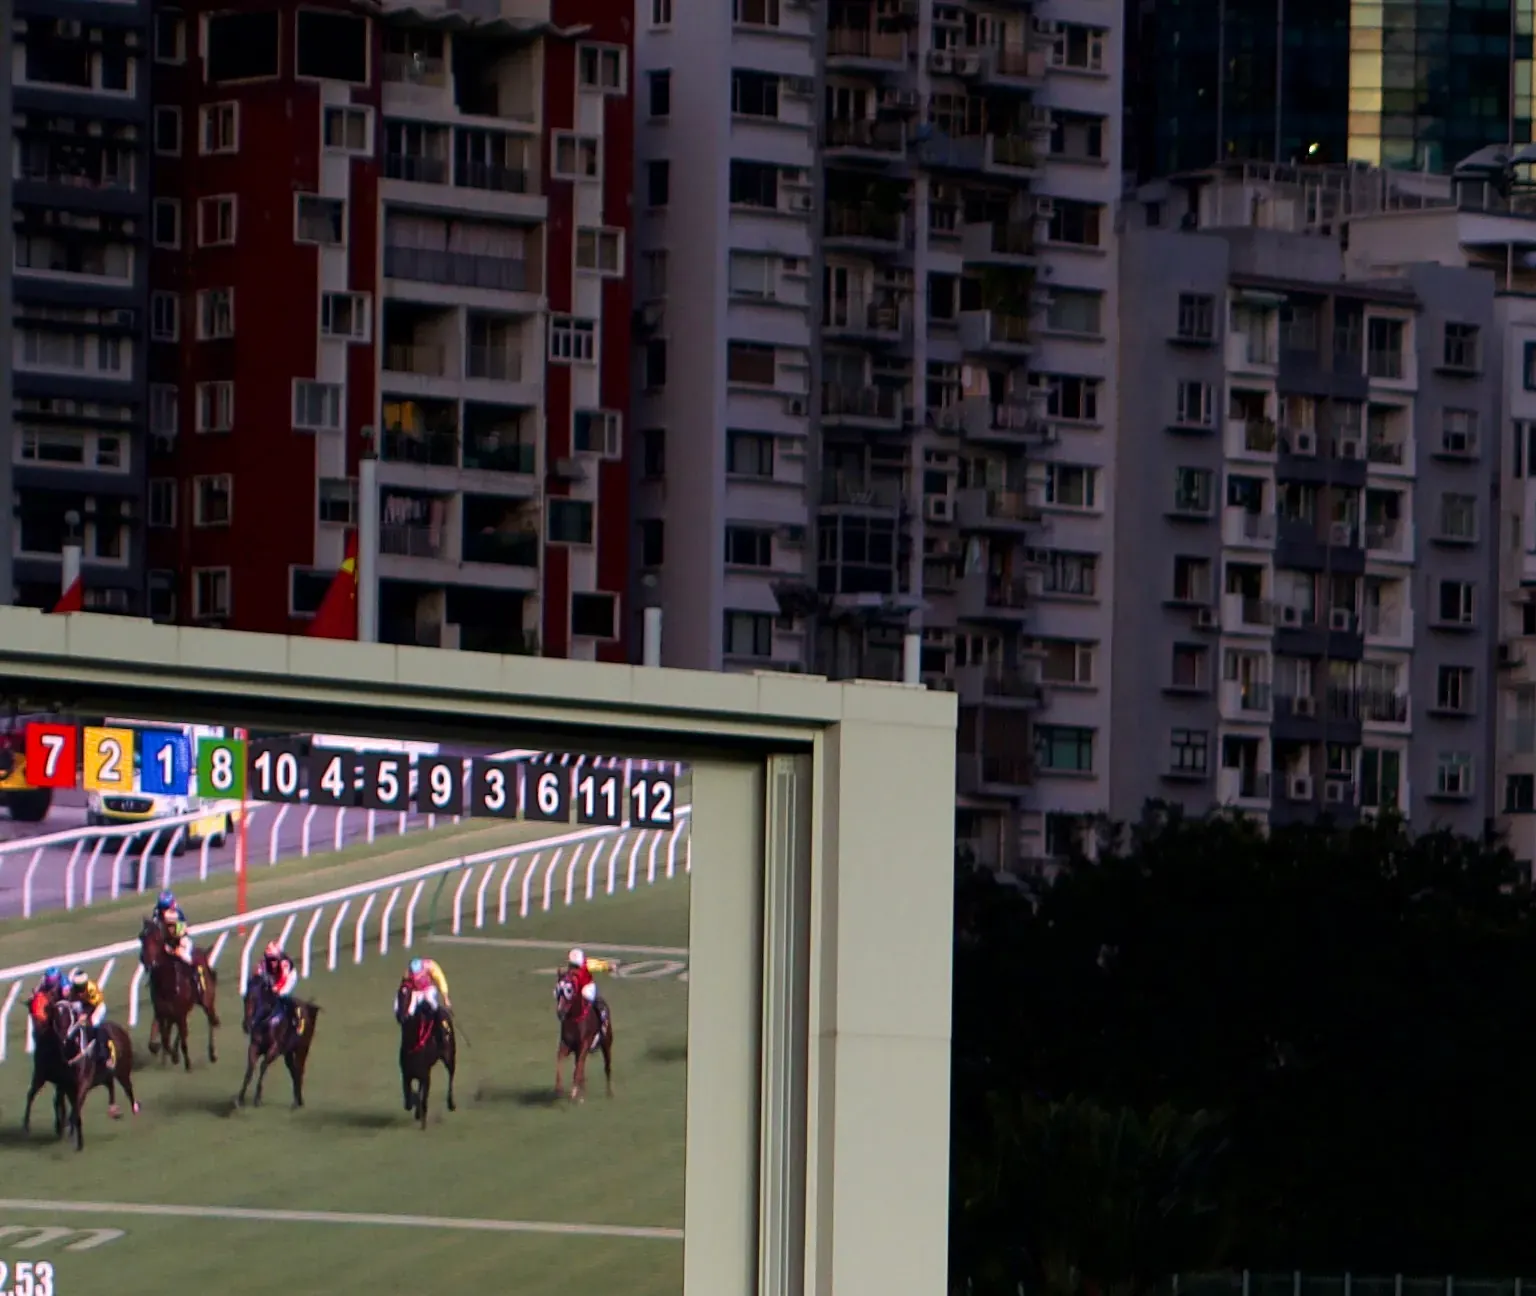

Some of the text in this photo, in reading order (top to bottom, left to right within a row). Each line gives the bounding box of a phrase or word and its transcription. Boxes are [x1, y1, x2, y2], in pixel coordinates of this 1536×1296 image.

[41, 735, 673, 823] 7 2 1 8 10 4 5 9 3 6 11 12
